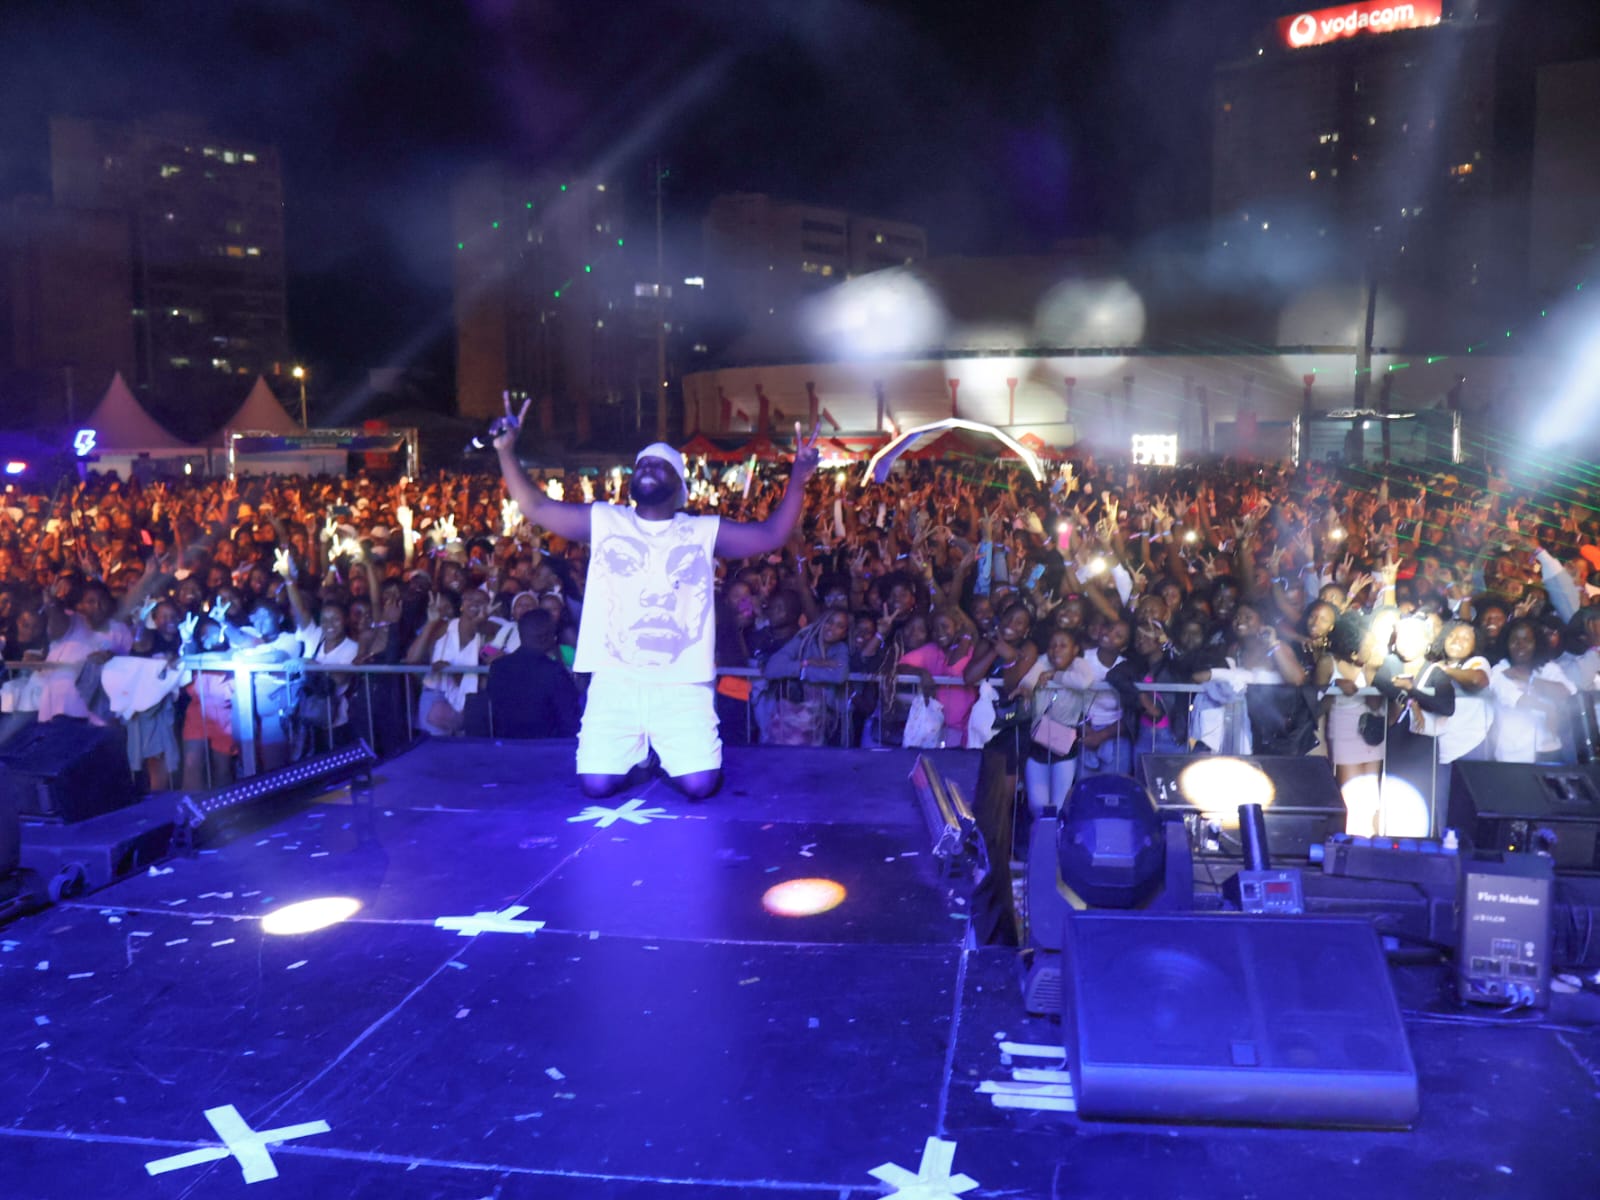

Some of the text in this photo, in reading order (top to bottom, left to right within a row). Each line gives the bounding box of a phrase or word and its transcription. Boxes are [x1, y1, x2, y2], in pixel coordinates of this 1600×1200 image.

[1320, 4, 1415, 35] vodacom
[1478, 892, 1540, 906] Fire Machine
